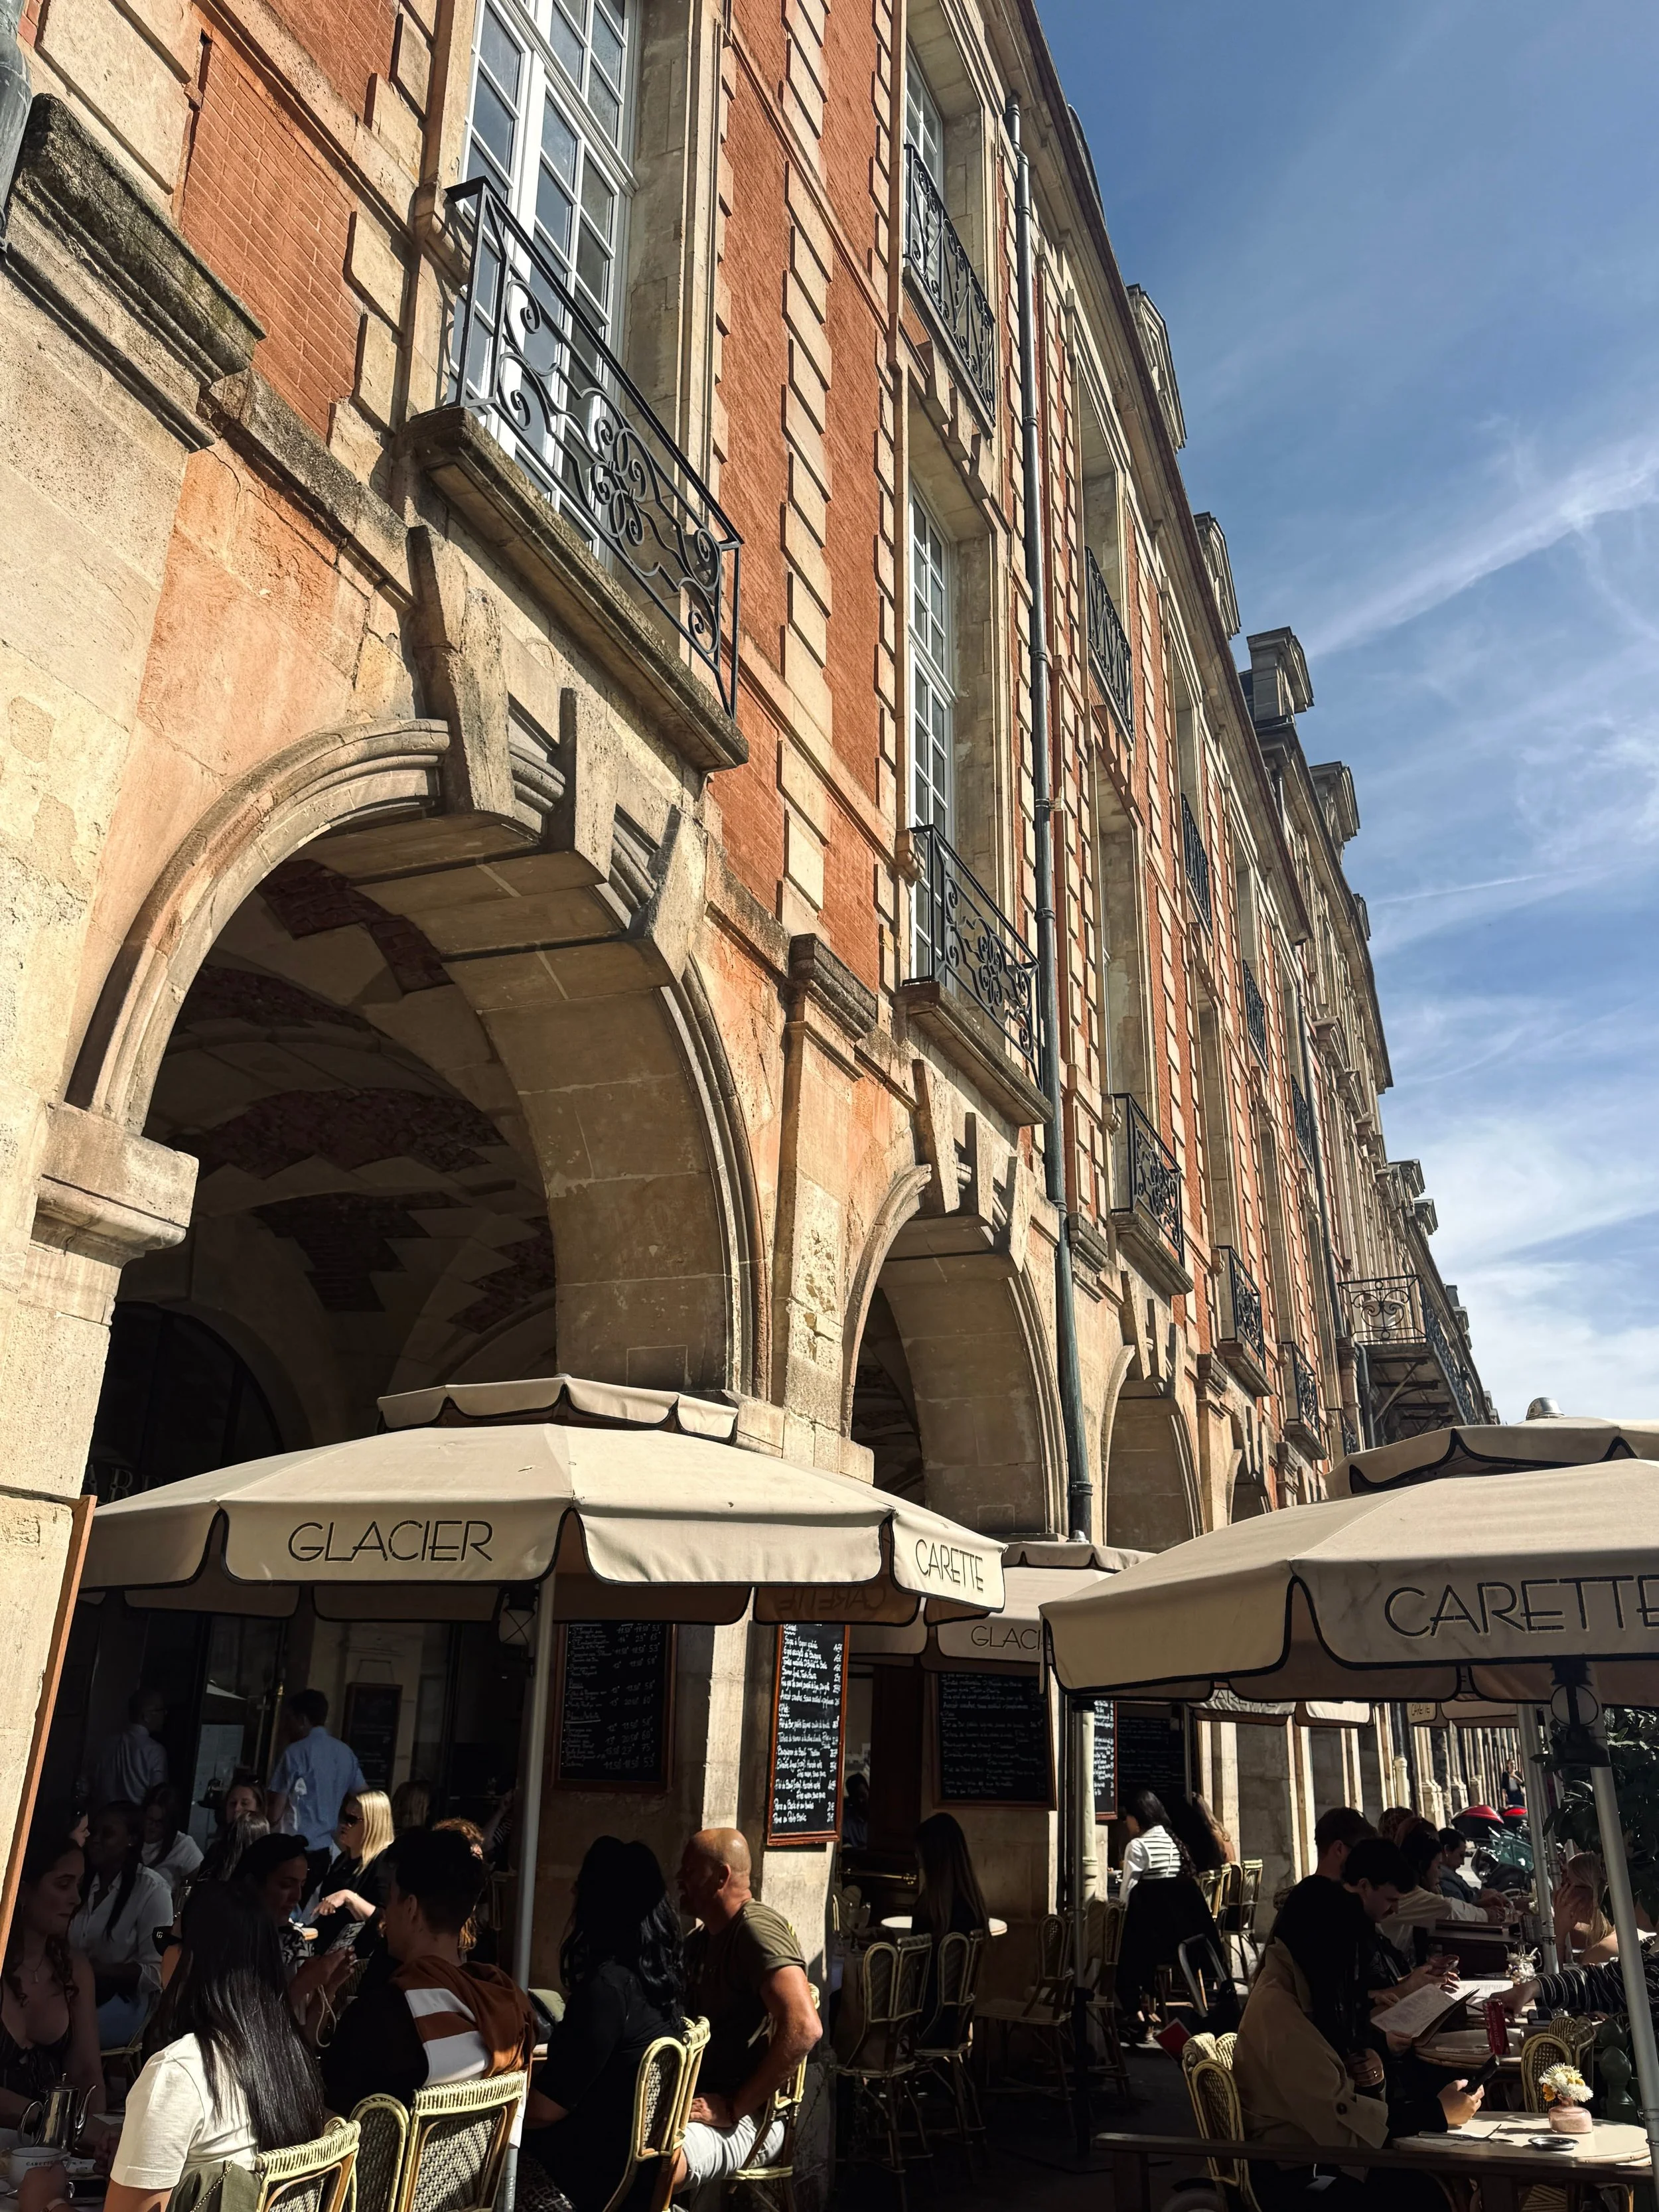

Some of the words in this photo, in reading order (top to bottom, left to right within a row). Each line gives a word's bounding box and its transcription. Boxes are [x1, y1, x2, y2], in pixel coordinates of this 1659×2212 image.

[288, 1520, 493, 1562] GLACIER
[916, 1538, 983, 1591] CARETTE
[971, 1625, 1052, 1651] GLACI
